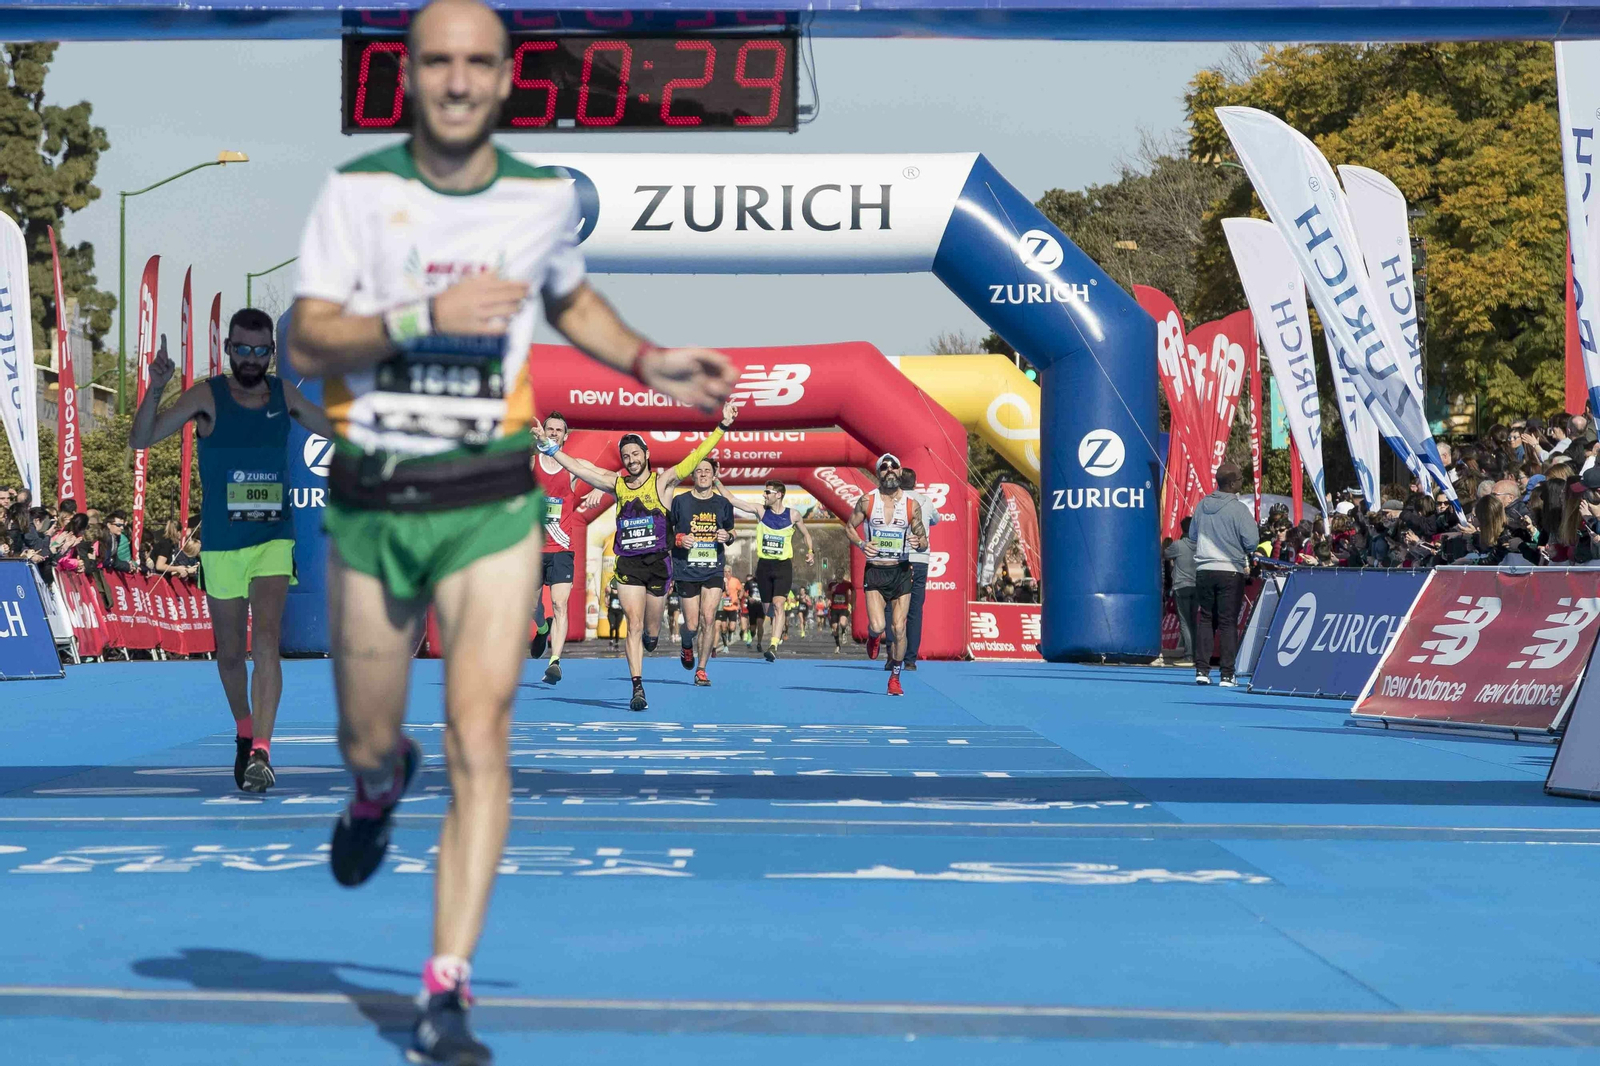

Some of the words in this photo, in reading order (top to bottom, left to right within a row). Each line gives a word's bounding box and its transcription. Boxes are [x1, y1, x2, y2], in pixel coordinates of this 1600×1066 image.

[631, 183, 893, 232] ZURICH
[988, 283, 1090, 304] ZURICH
[570, 389, 614, 405] new
[60, 386, 75, 500] balance
[723, 448, 731, 459] 3
[742, 450, 783, 459] correr
[246, 472, 277, 481] ZURICH
[246, 488, 269, 500] 809
[1052, 487, 1145, 511] ZURICH
[629, 518, 649, 526] ZURICH
[628, 528, 646, 538] 1467
[880, 540, 893, 548] 800
[1311, 611, 1405, 656] ZURICH
[1381, 675, 1411, 698] new
[1409, 672, 1467, 701] balance
[1474, 682, 1507, 704] new
[1502, 677, 1564, 707] balance
